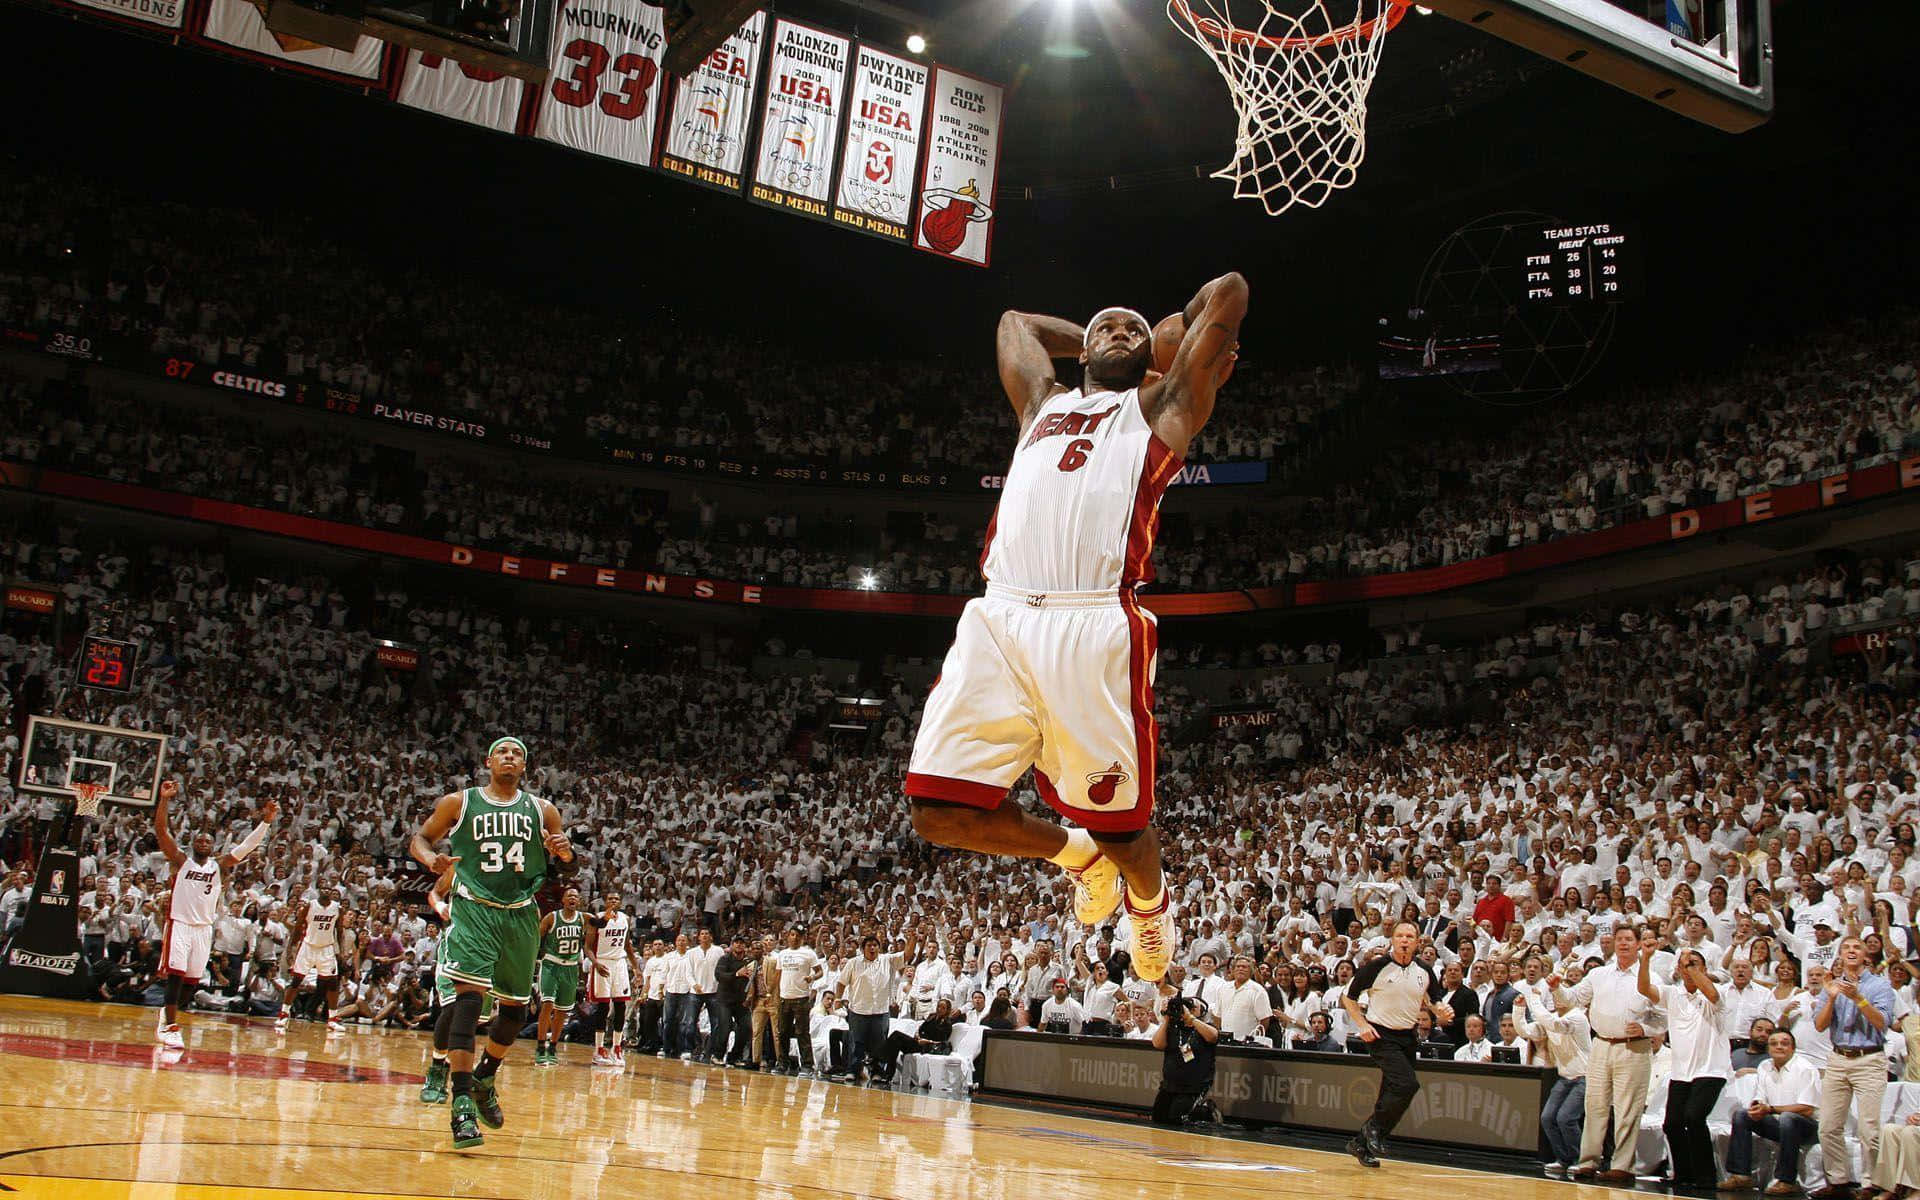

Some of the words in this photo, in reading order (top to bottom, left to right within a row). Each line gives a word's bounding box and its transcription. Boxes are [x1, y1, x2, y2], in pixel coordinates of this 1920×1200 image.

[565, 7, 662, 50] MOURNING
[786, 30, 838, 56] ALONZO
[777, 42, 844, 72] MOURNING
[551, 38, 658, 121] 33
[795, 69, 822, 82] 2000
[860, 54, 925, 85] DWYANE
[780, 74, 832, 106] USA
[869, 71, 913, 96] WADE
[954, 87, 985, 104] RON
[875, 93, 902, 108] 2008
[950, 96, 986, 114] CULP
[860, 99, 912, 131] USA
[937, 135, 988, 157] ATHLETIC
[951, 127, 978, 141] HEAD
[936, 145, 986, 167] TRAINER
[662, 157, 694, 177] GOLD
[697, 166, 740, 190] MEDAL
[752, 186, 783, 204] GOLD
[786, 195, 828, 217] MEDAL
[834, 209, 864, 227] GOLD
[866, 219, 907, 240] MEDAL
[1543, 227, 1573, 239] TEAM
[1575, 224, 1610, 236] STATS
[1558, 237, 1588, 249] HEAT
[1593, 235, 1625, 246] CELTICS
[1526, 255, 1551, 266] FTM
[1601, 248, 1616, 258] 14
[1527, 271, 1550, 282] FTA
[1567, 268, 1581, 279] 38
[1602, 265, 1616, 275] 20
[1528, 287, 1553, 299] FT%
[1568, 285, 1582, 295] 68
[1603, 281, 1617, 292] 70
[164, 357, 194, 381] 87
[212, 370, 288, 398] CELTICS
[373, 402, 434, 427] PLAYER
[436, 416, 487, 438] STATS
[611, 448, 636, 460] MIN
[664, 455, 689, 467] PTS
[694, 459, 706, 471] 10
[719, 462, 744, 473] REB
[1057, 439, 1094, 472] 6
[451, 546, 763, 604] DEFENSE
[87, 657, 123, 686] 23
[473, 811, 532, 841] CELTICS
[480, 842, 525, 873] 34
[184, 870, 216, 883] HEAT
[40, 895, 58, 905] NBA
[58, 896, 70, 907] TV
[204, 884, 213, 895] 3
[605, 926, 627, 937] HEAT
[611, 937, 624, 947] 22
[558, 940, 580, 954] 20
[18, 953, 78, 969] PLAYOFFS
[1070, 1057, 1138, 1088] THUNDER
[1263, 1075, 1313, 1105] NEXT
[1318, 1084, 1344, 1110] ON
